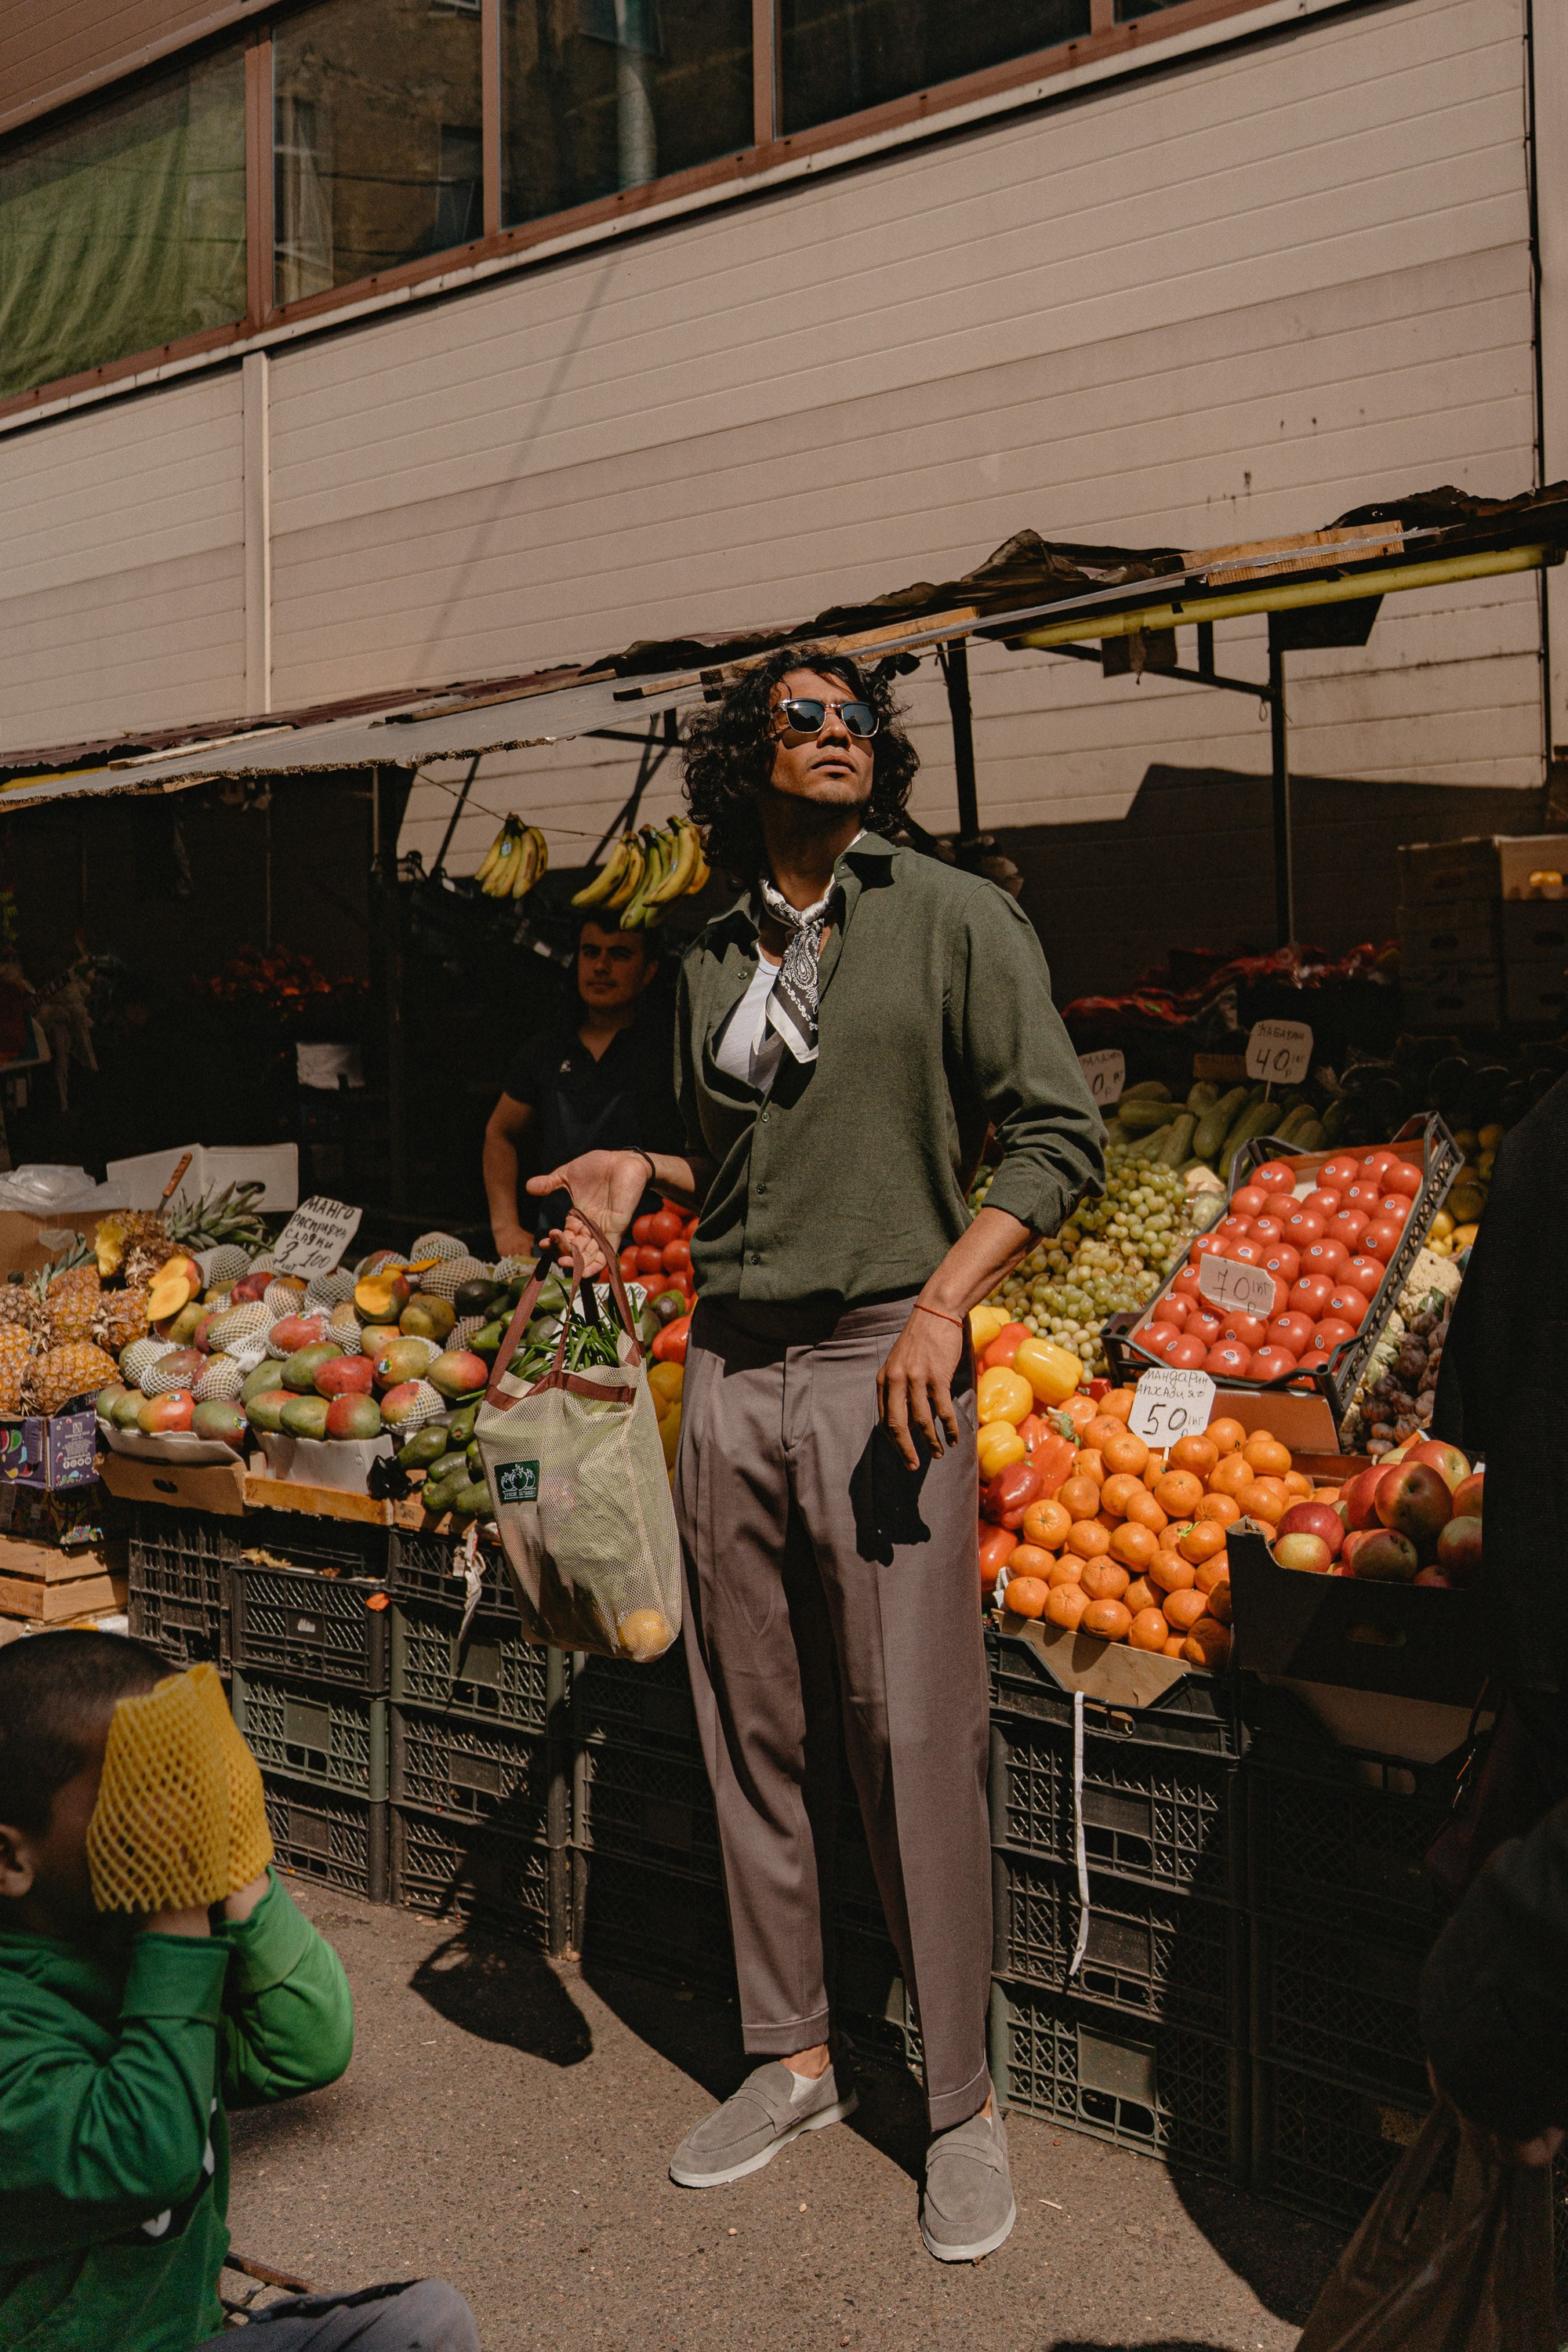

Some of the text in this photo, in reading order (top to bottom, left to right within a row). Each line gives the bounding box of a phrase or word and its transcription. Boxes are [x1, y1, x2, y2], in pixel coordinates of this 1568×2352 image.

[1256, 1048, 1290, 1075] 40
[303, 1197, 355, 1220] МАНГО
[274, 1241, 331, 1269] 3 100
[1212, 1269, 1250, 1302] 70
[1142, 1403, 1188, 1436] 50
